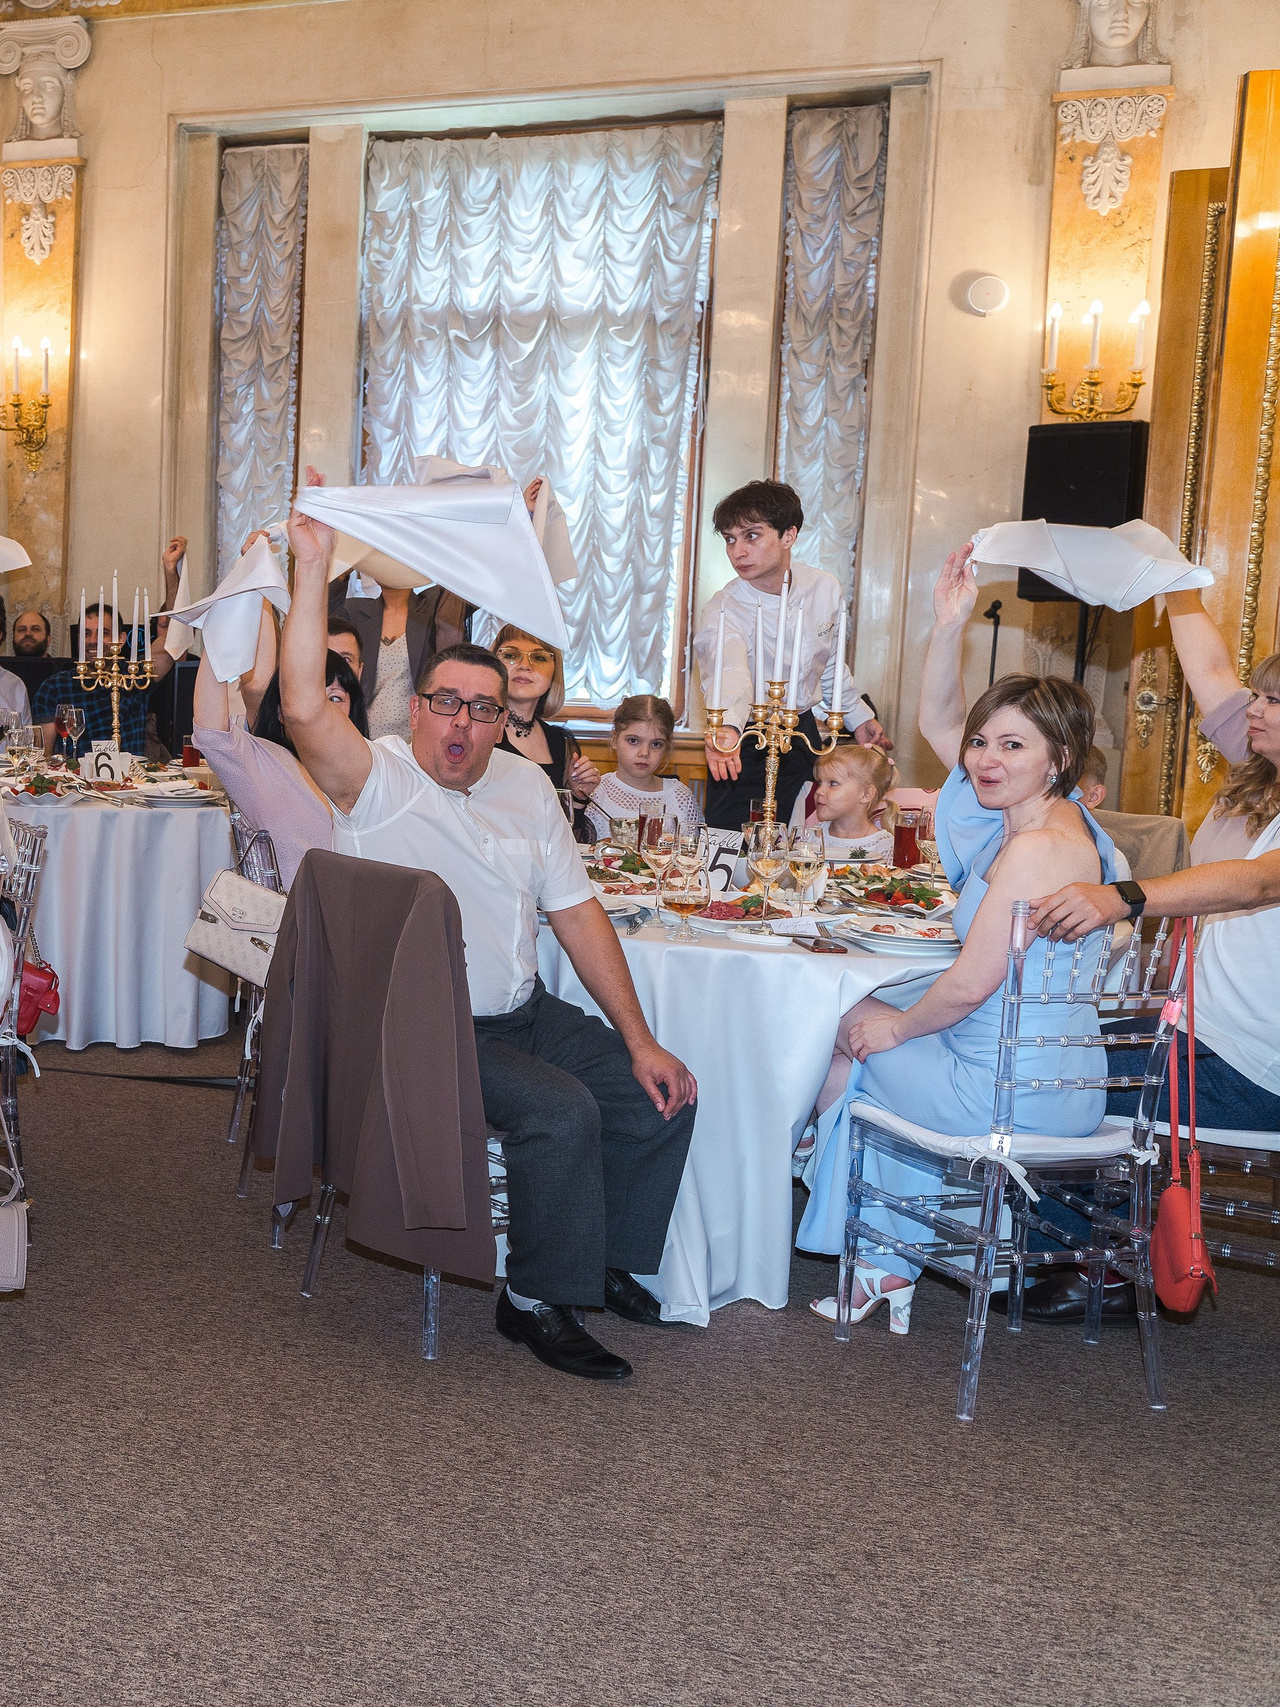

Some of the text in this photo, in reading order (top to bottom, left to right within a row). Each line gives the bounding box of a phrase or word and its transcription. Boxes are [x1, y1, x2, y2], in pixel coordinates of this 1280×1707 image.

[93, 742, 118, 753] table
[95, 752, 115, 781] 6
[707, 832, 742, 848] table
[708, 847, 739, 892] 5
